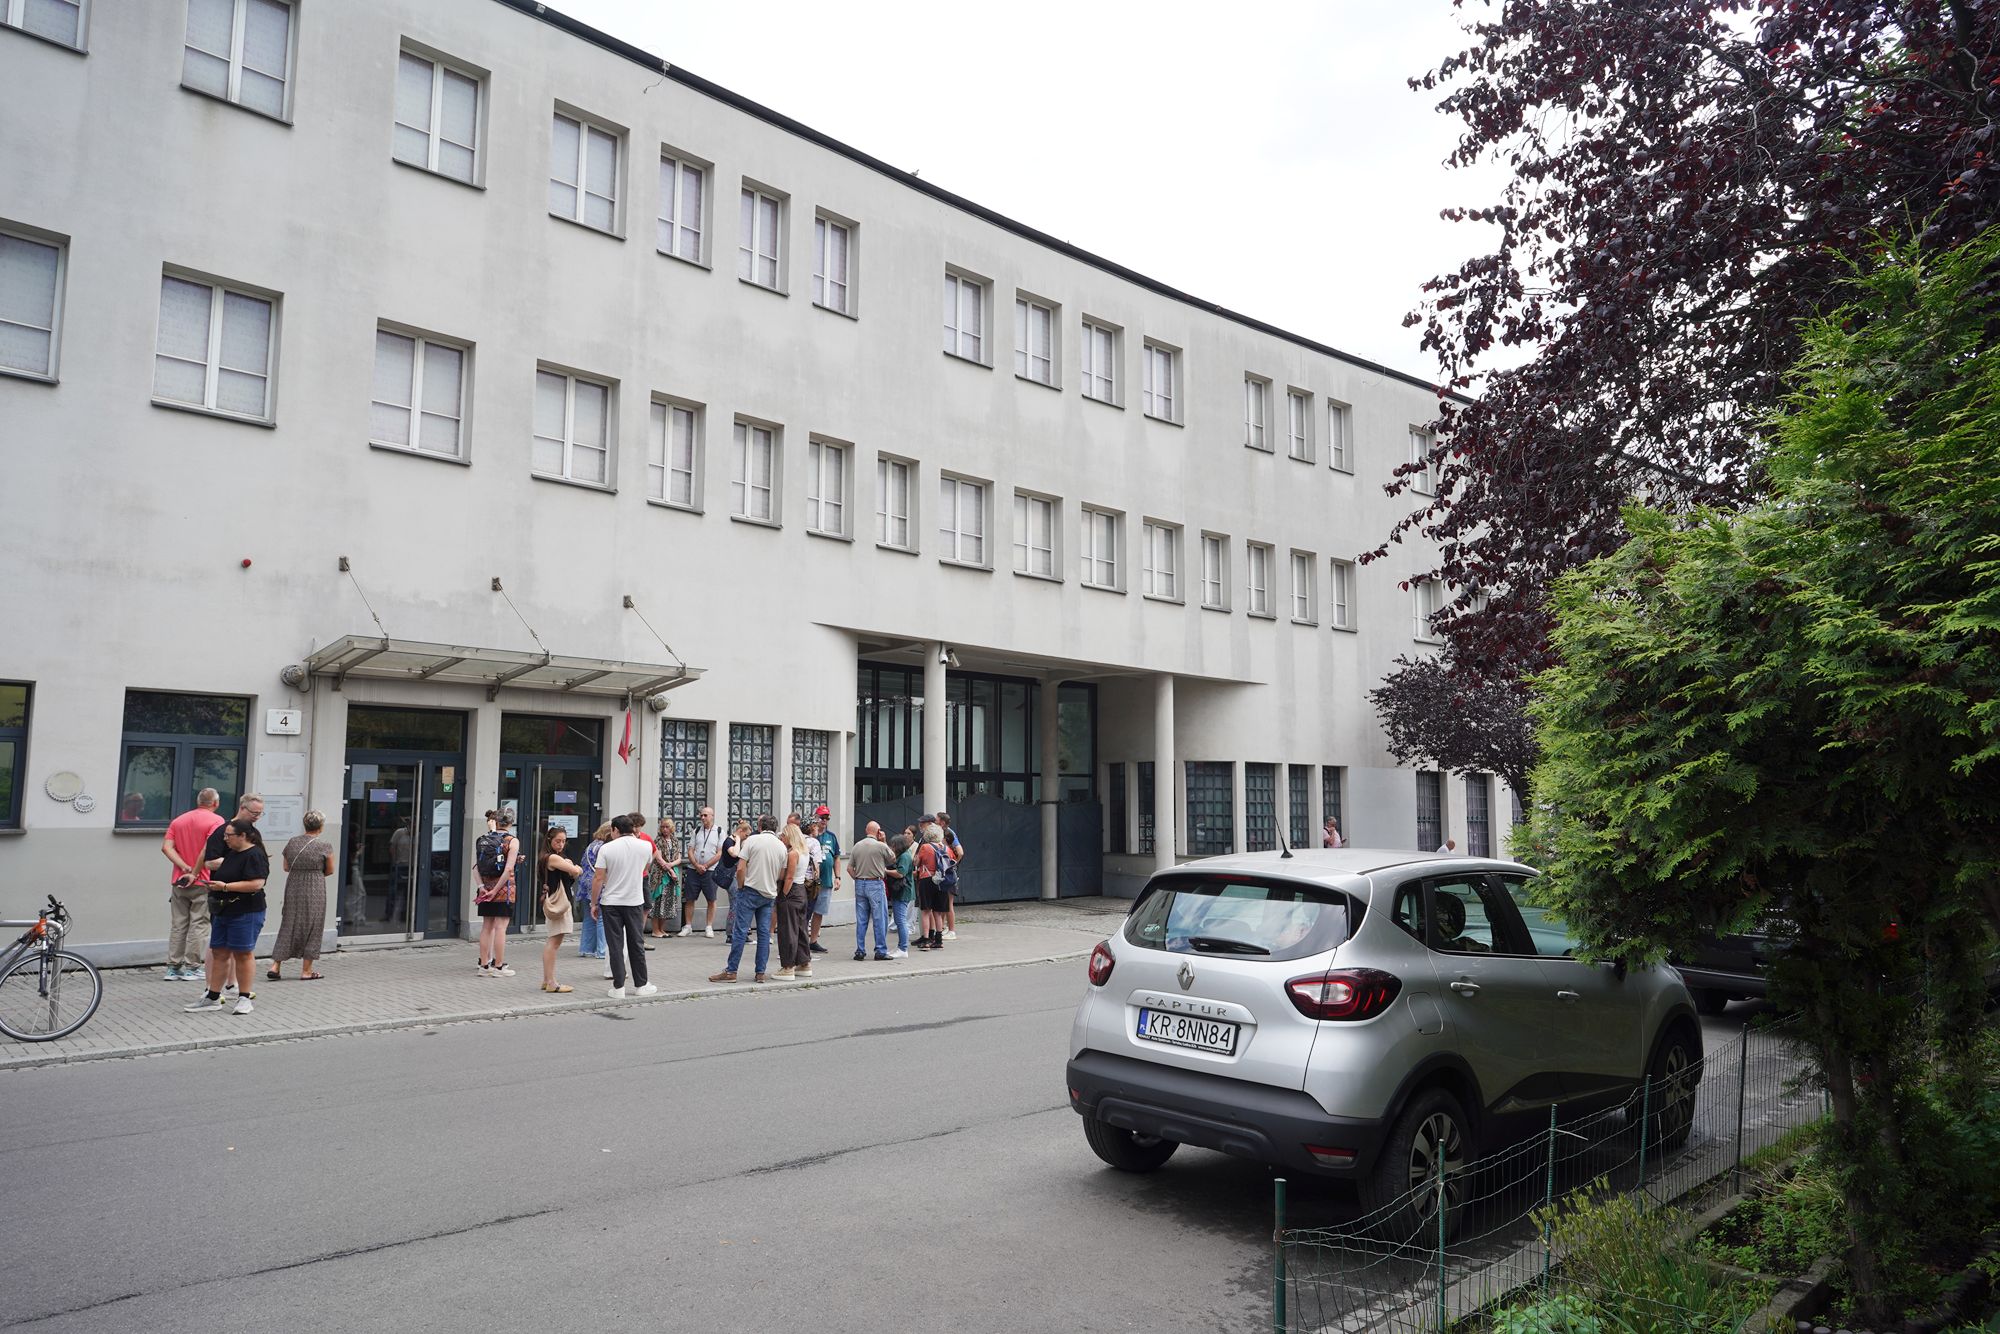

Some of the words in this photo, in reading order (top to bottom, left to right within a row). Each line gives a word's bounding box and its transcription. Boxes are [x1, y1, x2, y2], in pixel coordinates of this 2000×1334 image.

[280, 715, 289, 727] 4
[1145, 996, 1227, 1017] CAPTUR
[1149, 1013, 1172, 1036] KR
[1176, 1018, 1232, 1048] 8NN84
